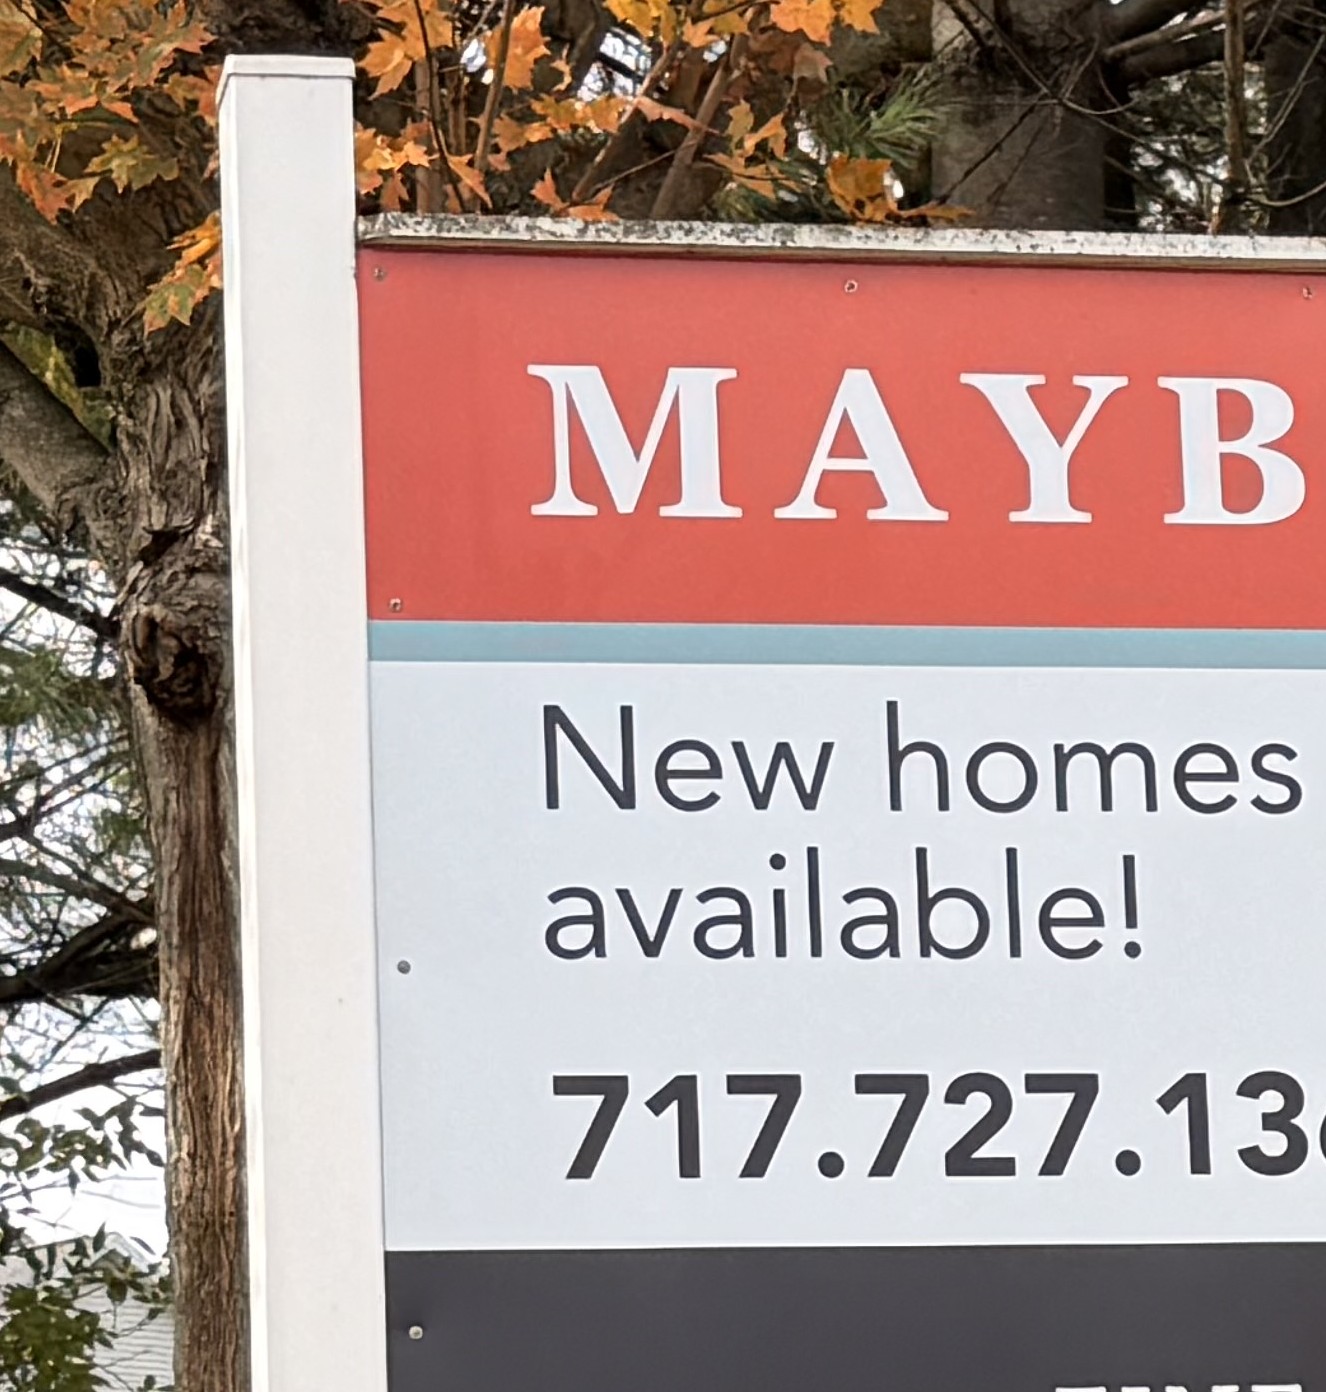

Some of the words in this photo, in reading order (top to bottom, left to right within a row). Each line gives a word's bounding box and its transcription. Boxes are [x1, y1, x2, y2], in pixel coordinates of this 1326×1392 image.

[543, 704, 835, 813] New
[886, 700, 1303, 815] homes
[544, 846, 1142, 960] available!
